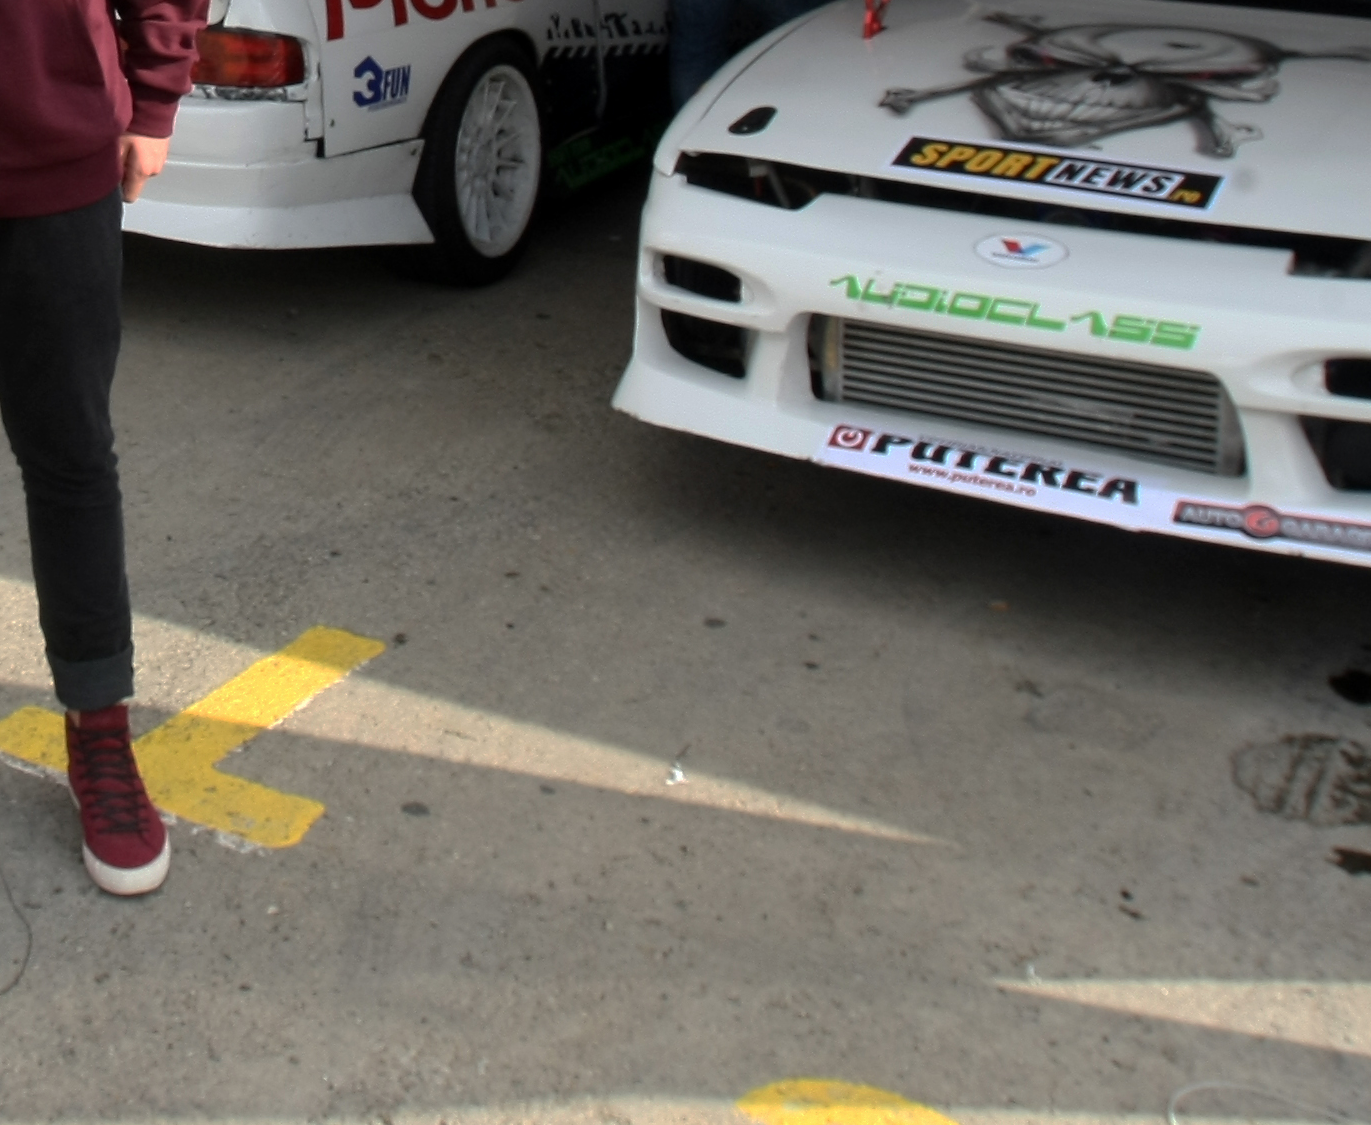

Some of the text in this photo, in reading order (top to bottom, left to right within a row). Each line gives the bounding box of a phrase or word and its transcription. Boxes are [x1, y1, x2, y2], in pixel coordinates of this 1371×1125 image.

[829, 274, 1202, 351] AUDIOCLASS
[871, 433, 1140, 505] PUTEREA
[908, 463, 1037, 497] www.puterea.ro
[1181, 505, 1244, 529] AUTO
